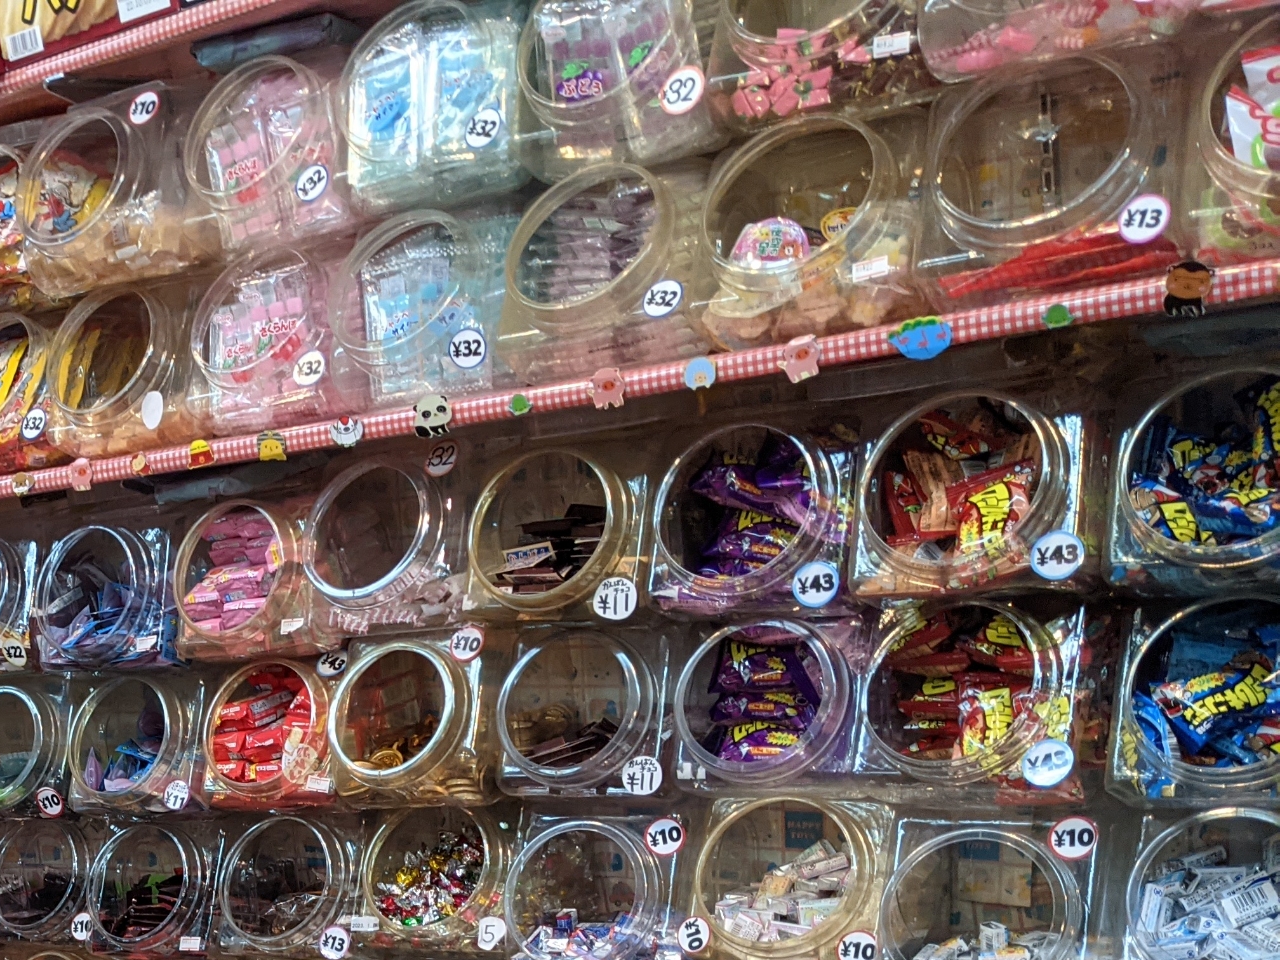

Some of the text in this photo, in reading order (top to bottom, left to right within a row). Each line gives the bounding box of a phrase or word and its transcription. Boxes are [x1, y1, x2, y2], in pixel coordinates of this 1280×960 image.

[467, 118, 498, 140] ¥32
[297, 170, 327, 198] ¥32
[1123, 208, 1162, 230] ¥13
[647, 288, 678, 308] ¥32
[451, 338, 482, 358] ¥32
[297, 358, 322, 377] ¥32
[23, 414, 45, 434] ¥32
[1037, 544, 1079, 566] ¥43
[797, 573, 835, 595] ¥43
[453, 634, 480, 652] ¥10
[38, 793, 61, 811] ¥10
[649, 825, 681, 846] ¥10
[1054, 828, 1094, 849] ¥10
[322, 932, 349, 952] ¥13
